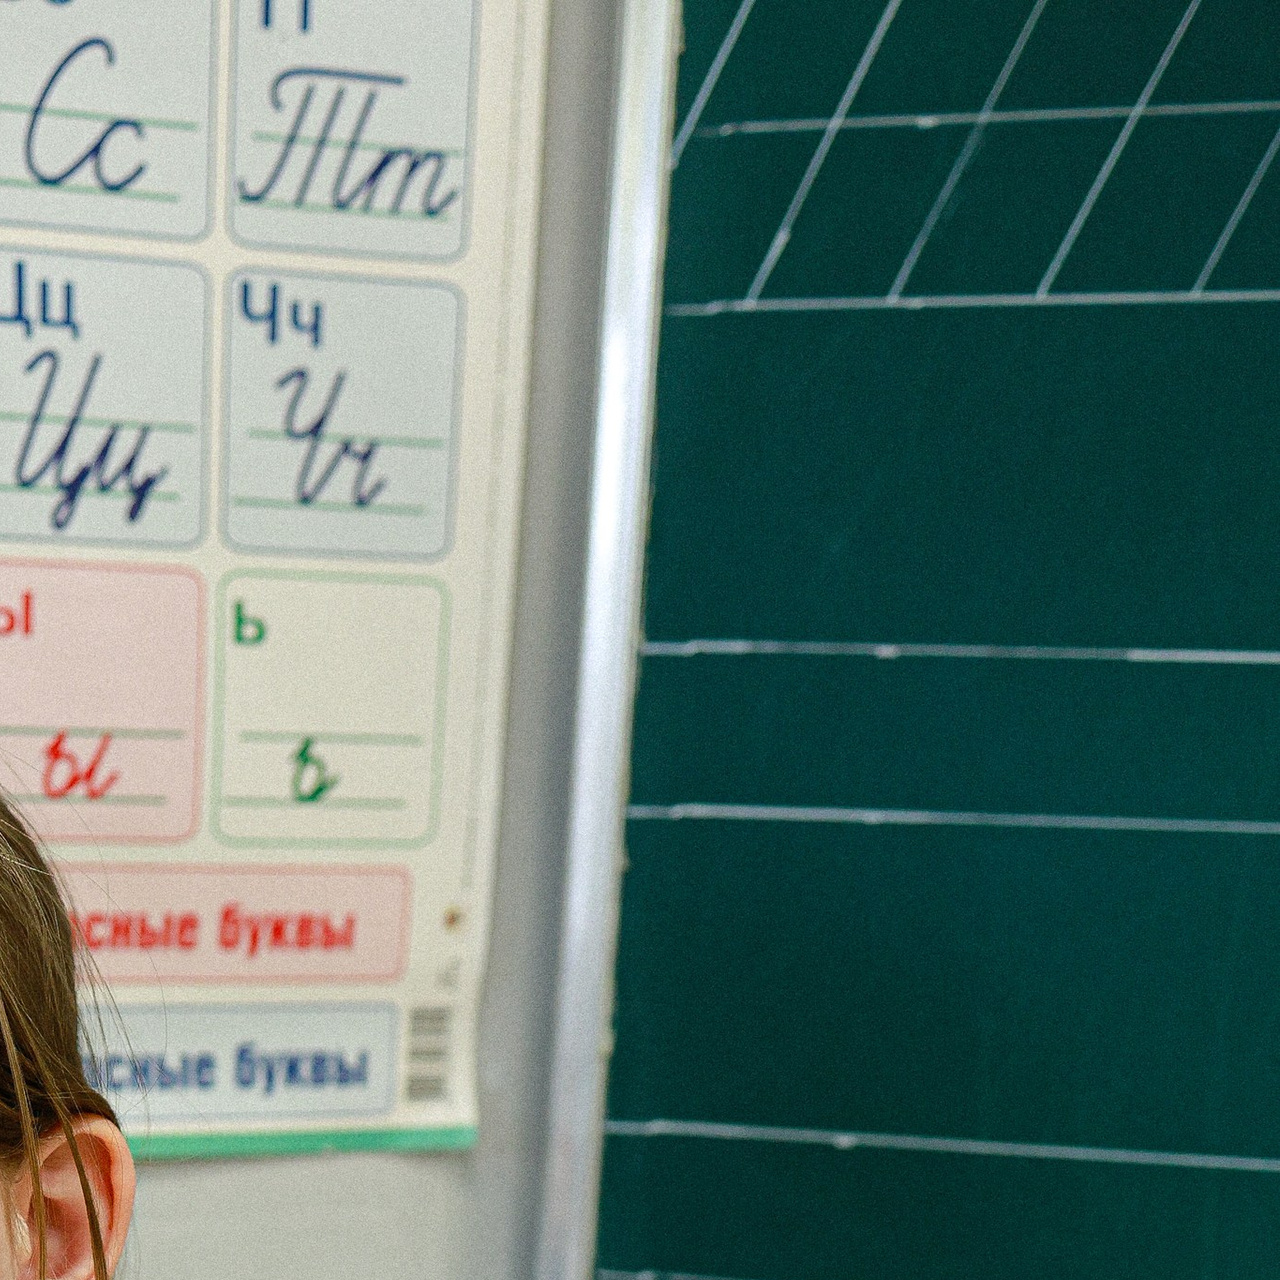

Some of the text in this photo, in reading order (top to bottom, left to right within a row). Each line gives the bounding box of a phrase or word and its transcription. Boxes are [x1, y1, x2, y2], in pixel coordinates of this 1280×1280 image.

[24, 37, 147, 192] Сс
[239, 67, 458, 217] Тт
[241, 280, 323, 347] Чч
[15, 349, 168, 530] Цц
[275, 367, 389, 506] Чч
[68, 901, 357, 958] сные буквы
[235, 1039, 369, 1097] буквы
